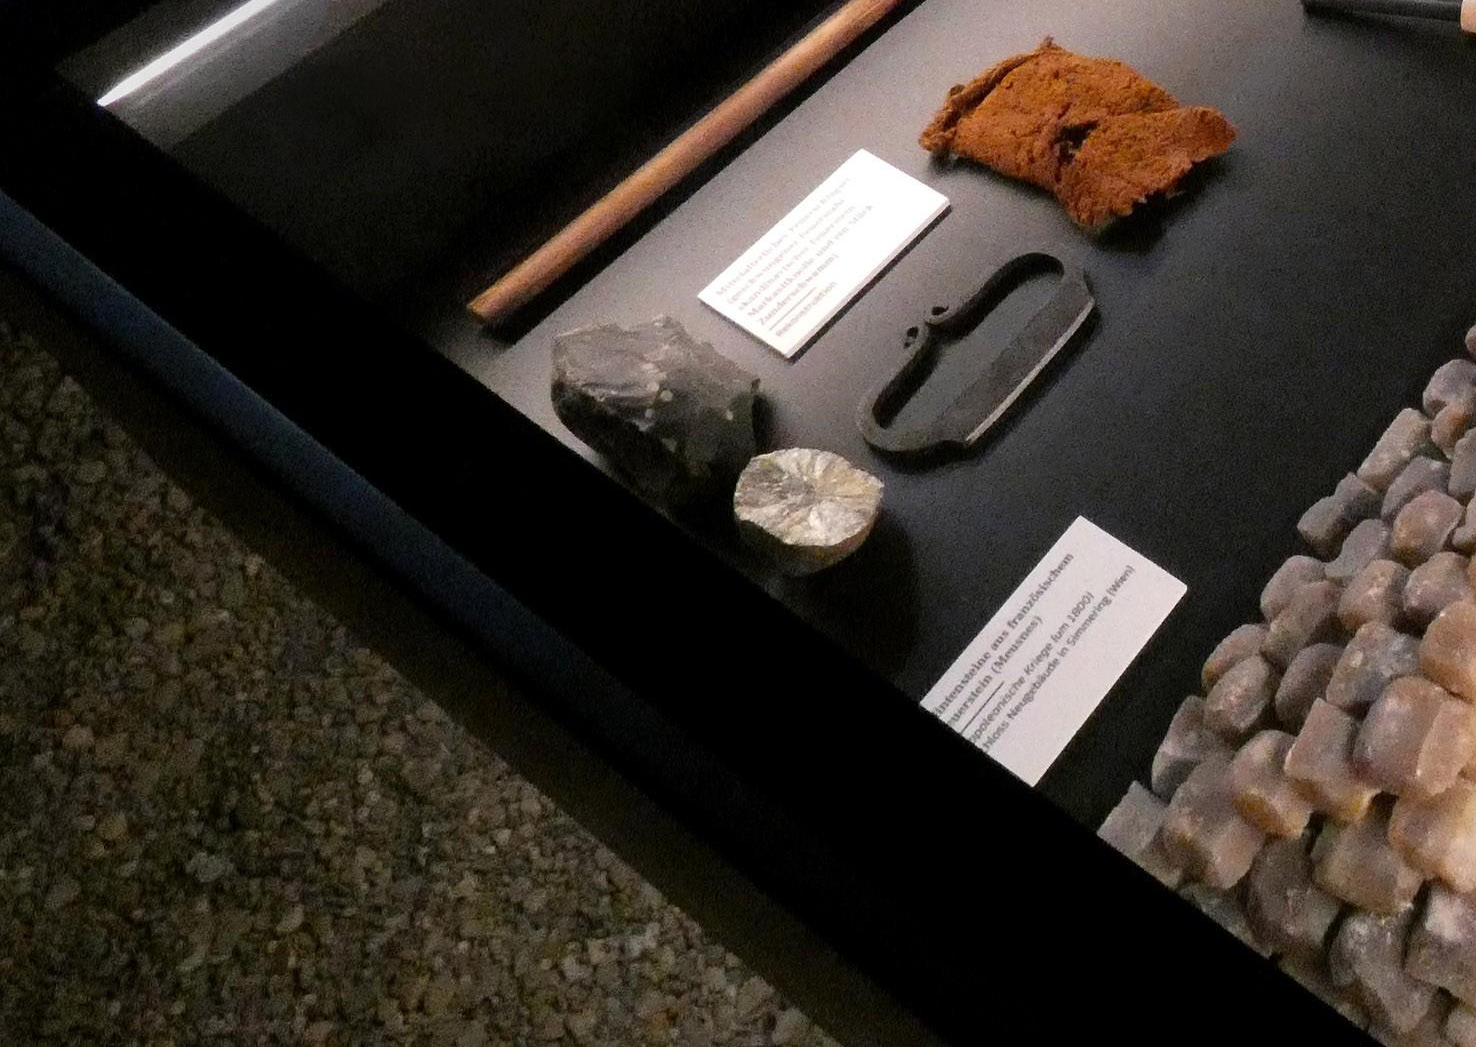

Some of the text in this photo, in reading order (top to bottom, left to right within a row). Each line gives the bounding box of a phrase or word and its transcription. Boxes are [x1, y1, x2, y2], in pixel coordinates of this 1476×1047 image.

[990, 629, 1009, 651] aus
[1006, 553, 1073, 630] französischem
[990, 614, 1042, 675] (Meusnes)
[1006, 657, 1060, 720] Neugebäude
[1057, 646, 1069, 658] in
[1065, 595, 1112, 647] Simmering
[1106, 564, 1135, 597] (Wien)
[1023, 642, 1053, 676] Kriege
[1050, 621, 1070, 644] (um
[1066, 591, 1095, 622] 1800)
